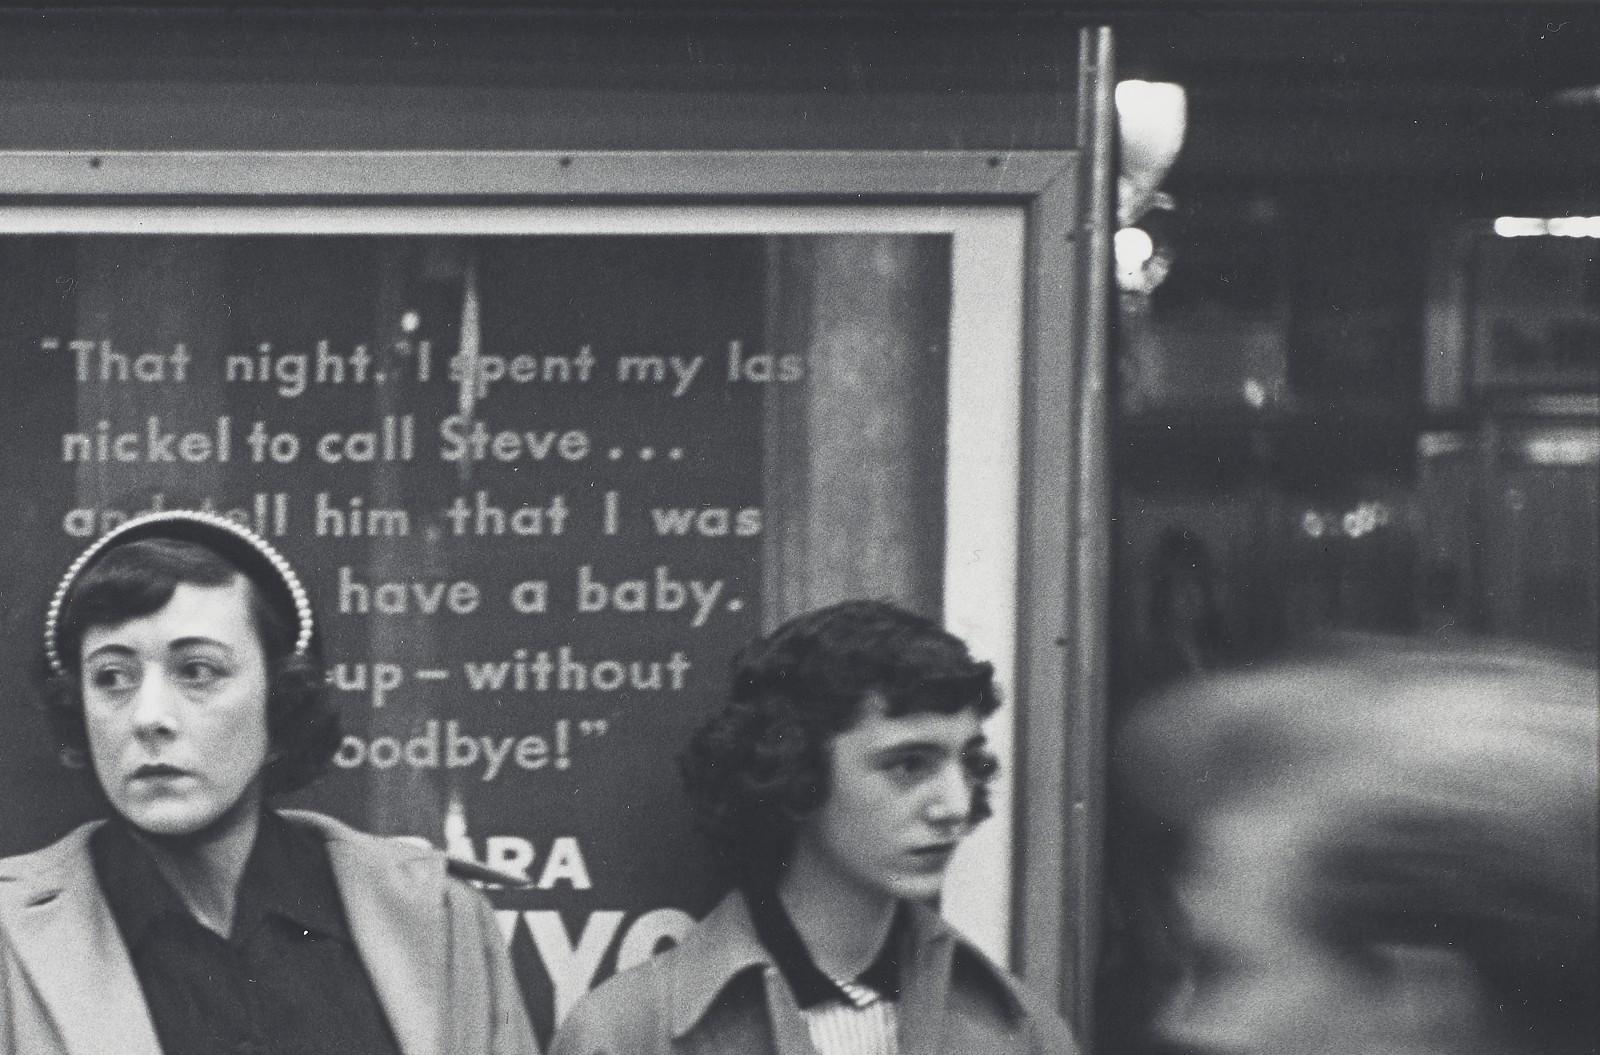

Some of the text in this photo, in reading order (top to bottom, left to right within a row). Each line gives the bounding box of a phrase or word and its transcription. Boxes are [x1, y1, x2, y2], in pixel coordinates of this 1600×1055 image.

[419, 339, 431, 383] I
[449, 344, 596, 399] spent
[617, 352, 703, 398] my
[727, 338, 804, 384] las
[62, 414, 231, 463] nickel
[247, 419, 300, 464] to
[316, 413, 415, 463] call
[316, 492, 411, 537] him
[447, 490, 570, 537] that
[604, 490, 618, 537] I
[652, 507, 763, 538] was
[338, 564, 743, 628] have a baby.
[463, 646, 691, 691] without
[332, 718, 609, 782] oodbye!”
